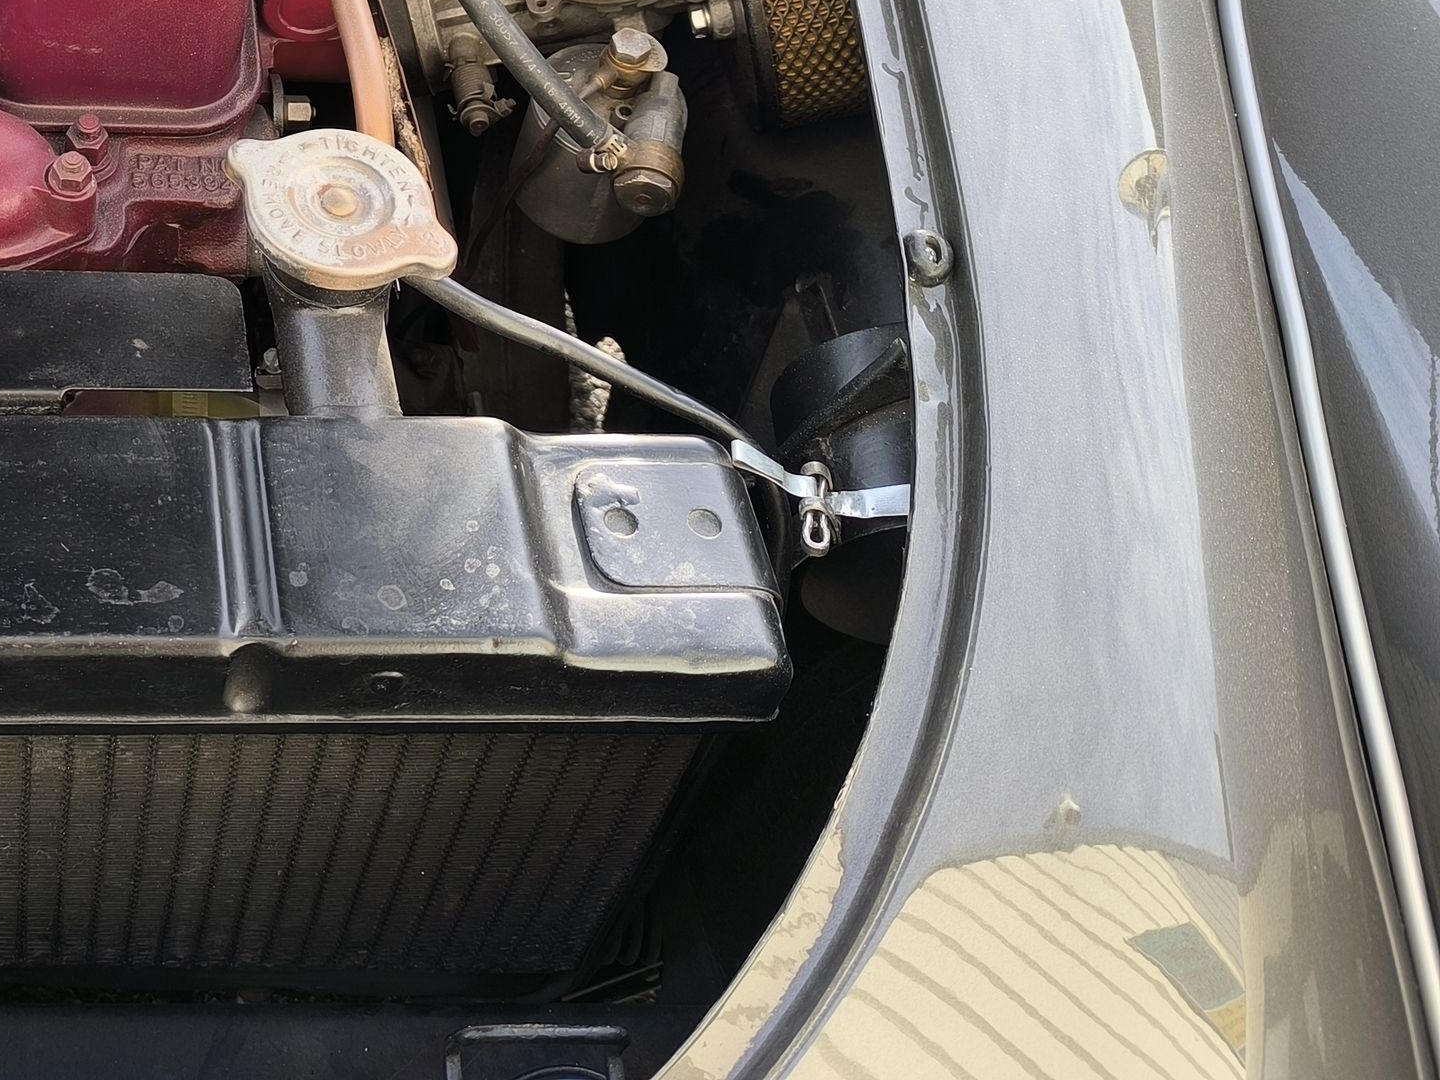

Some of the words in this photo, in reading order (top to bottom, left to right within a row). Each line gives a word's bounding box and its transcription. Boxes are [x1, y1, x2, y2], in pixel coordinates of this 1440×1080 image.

[135, 153, 188, 174] PAT
[200, 157, 227, 177] N
[315, 134, 419, 193] TIGHTEN
